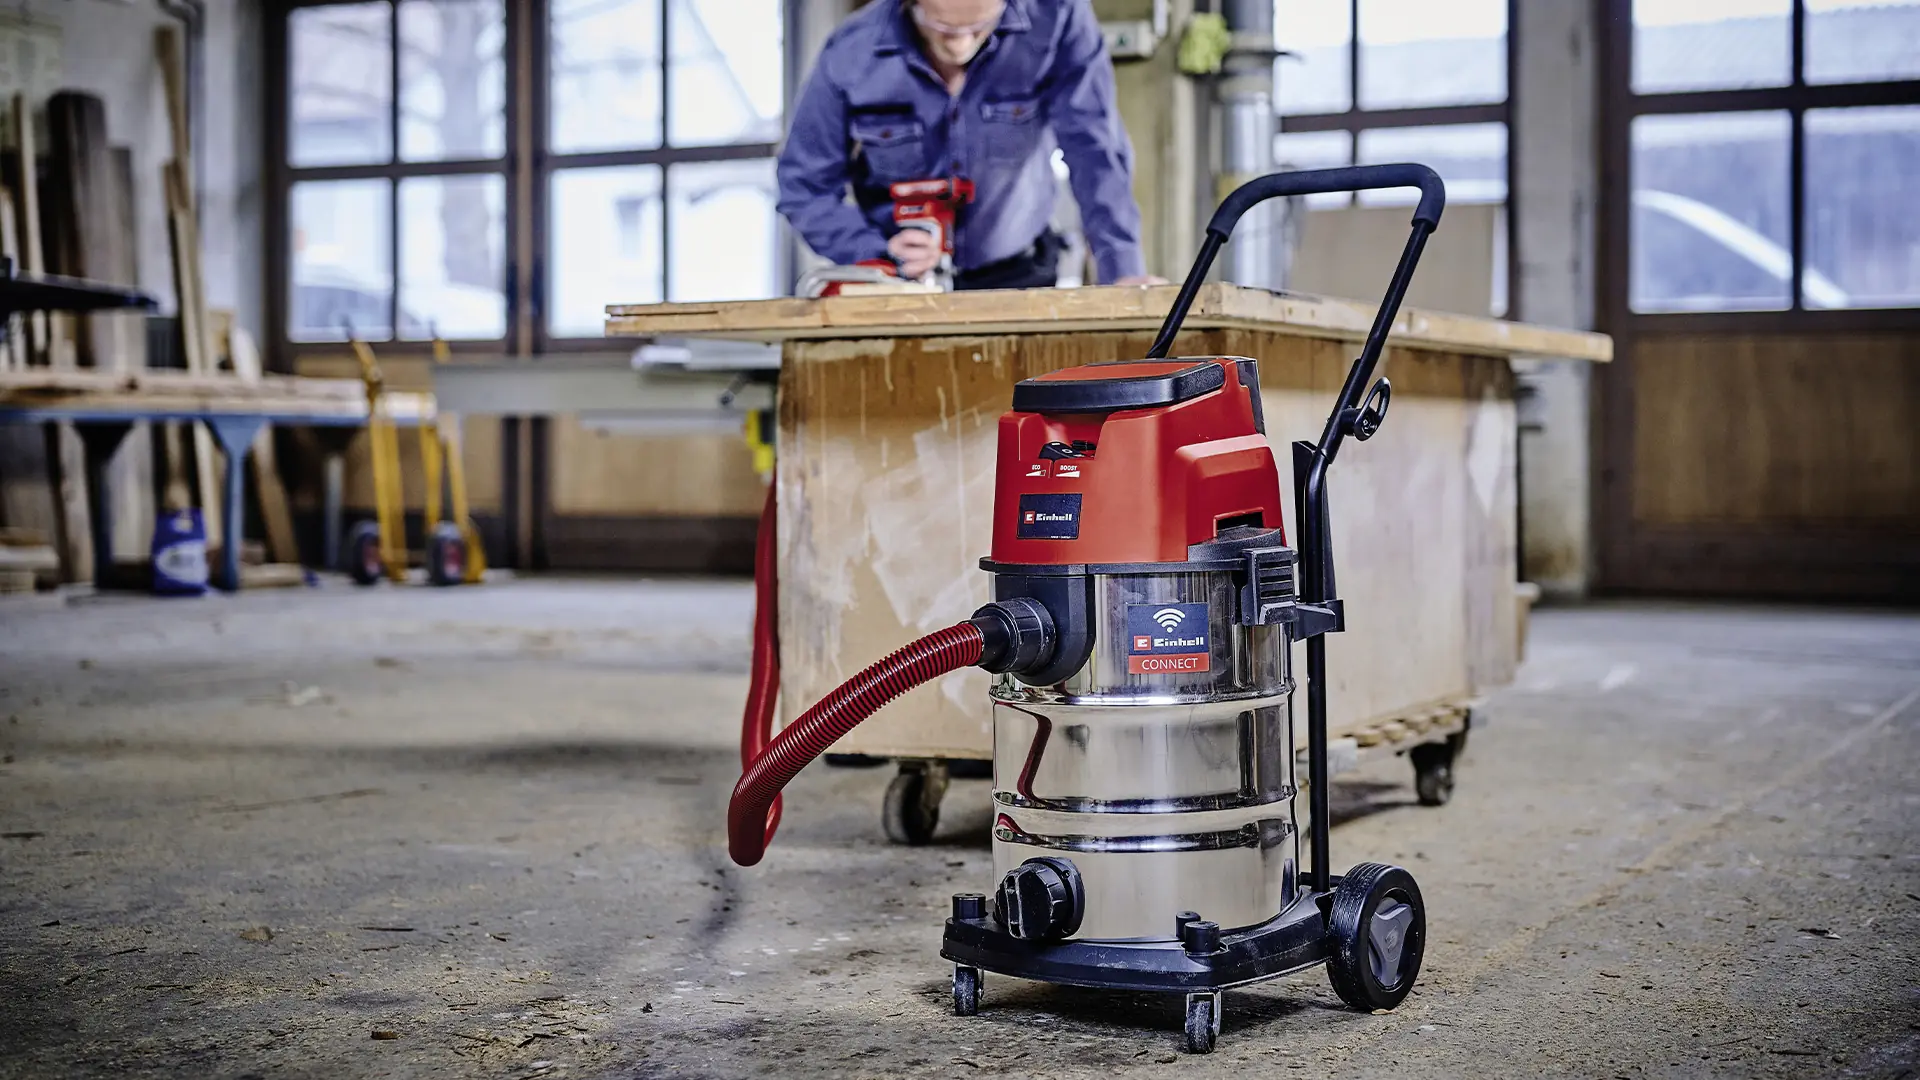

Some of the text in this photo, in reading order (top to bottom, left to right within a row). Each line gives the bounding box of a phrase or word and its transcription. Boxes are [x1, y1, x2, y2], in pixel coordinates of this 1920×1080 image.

[1035, 513, 1073, 521] Einhell
[1153, 636, 1204, 647] Einhell
[1141, 657, 1199, 671] CONNECT
